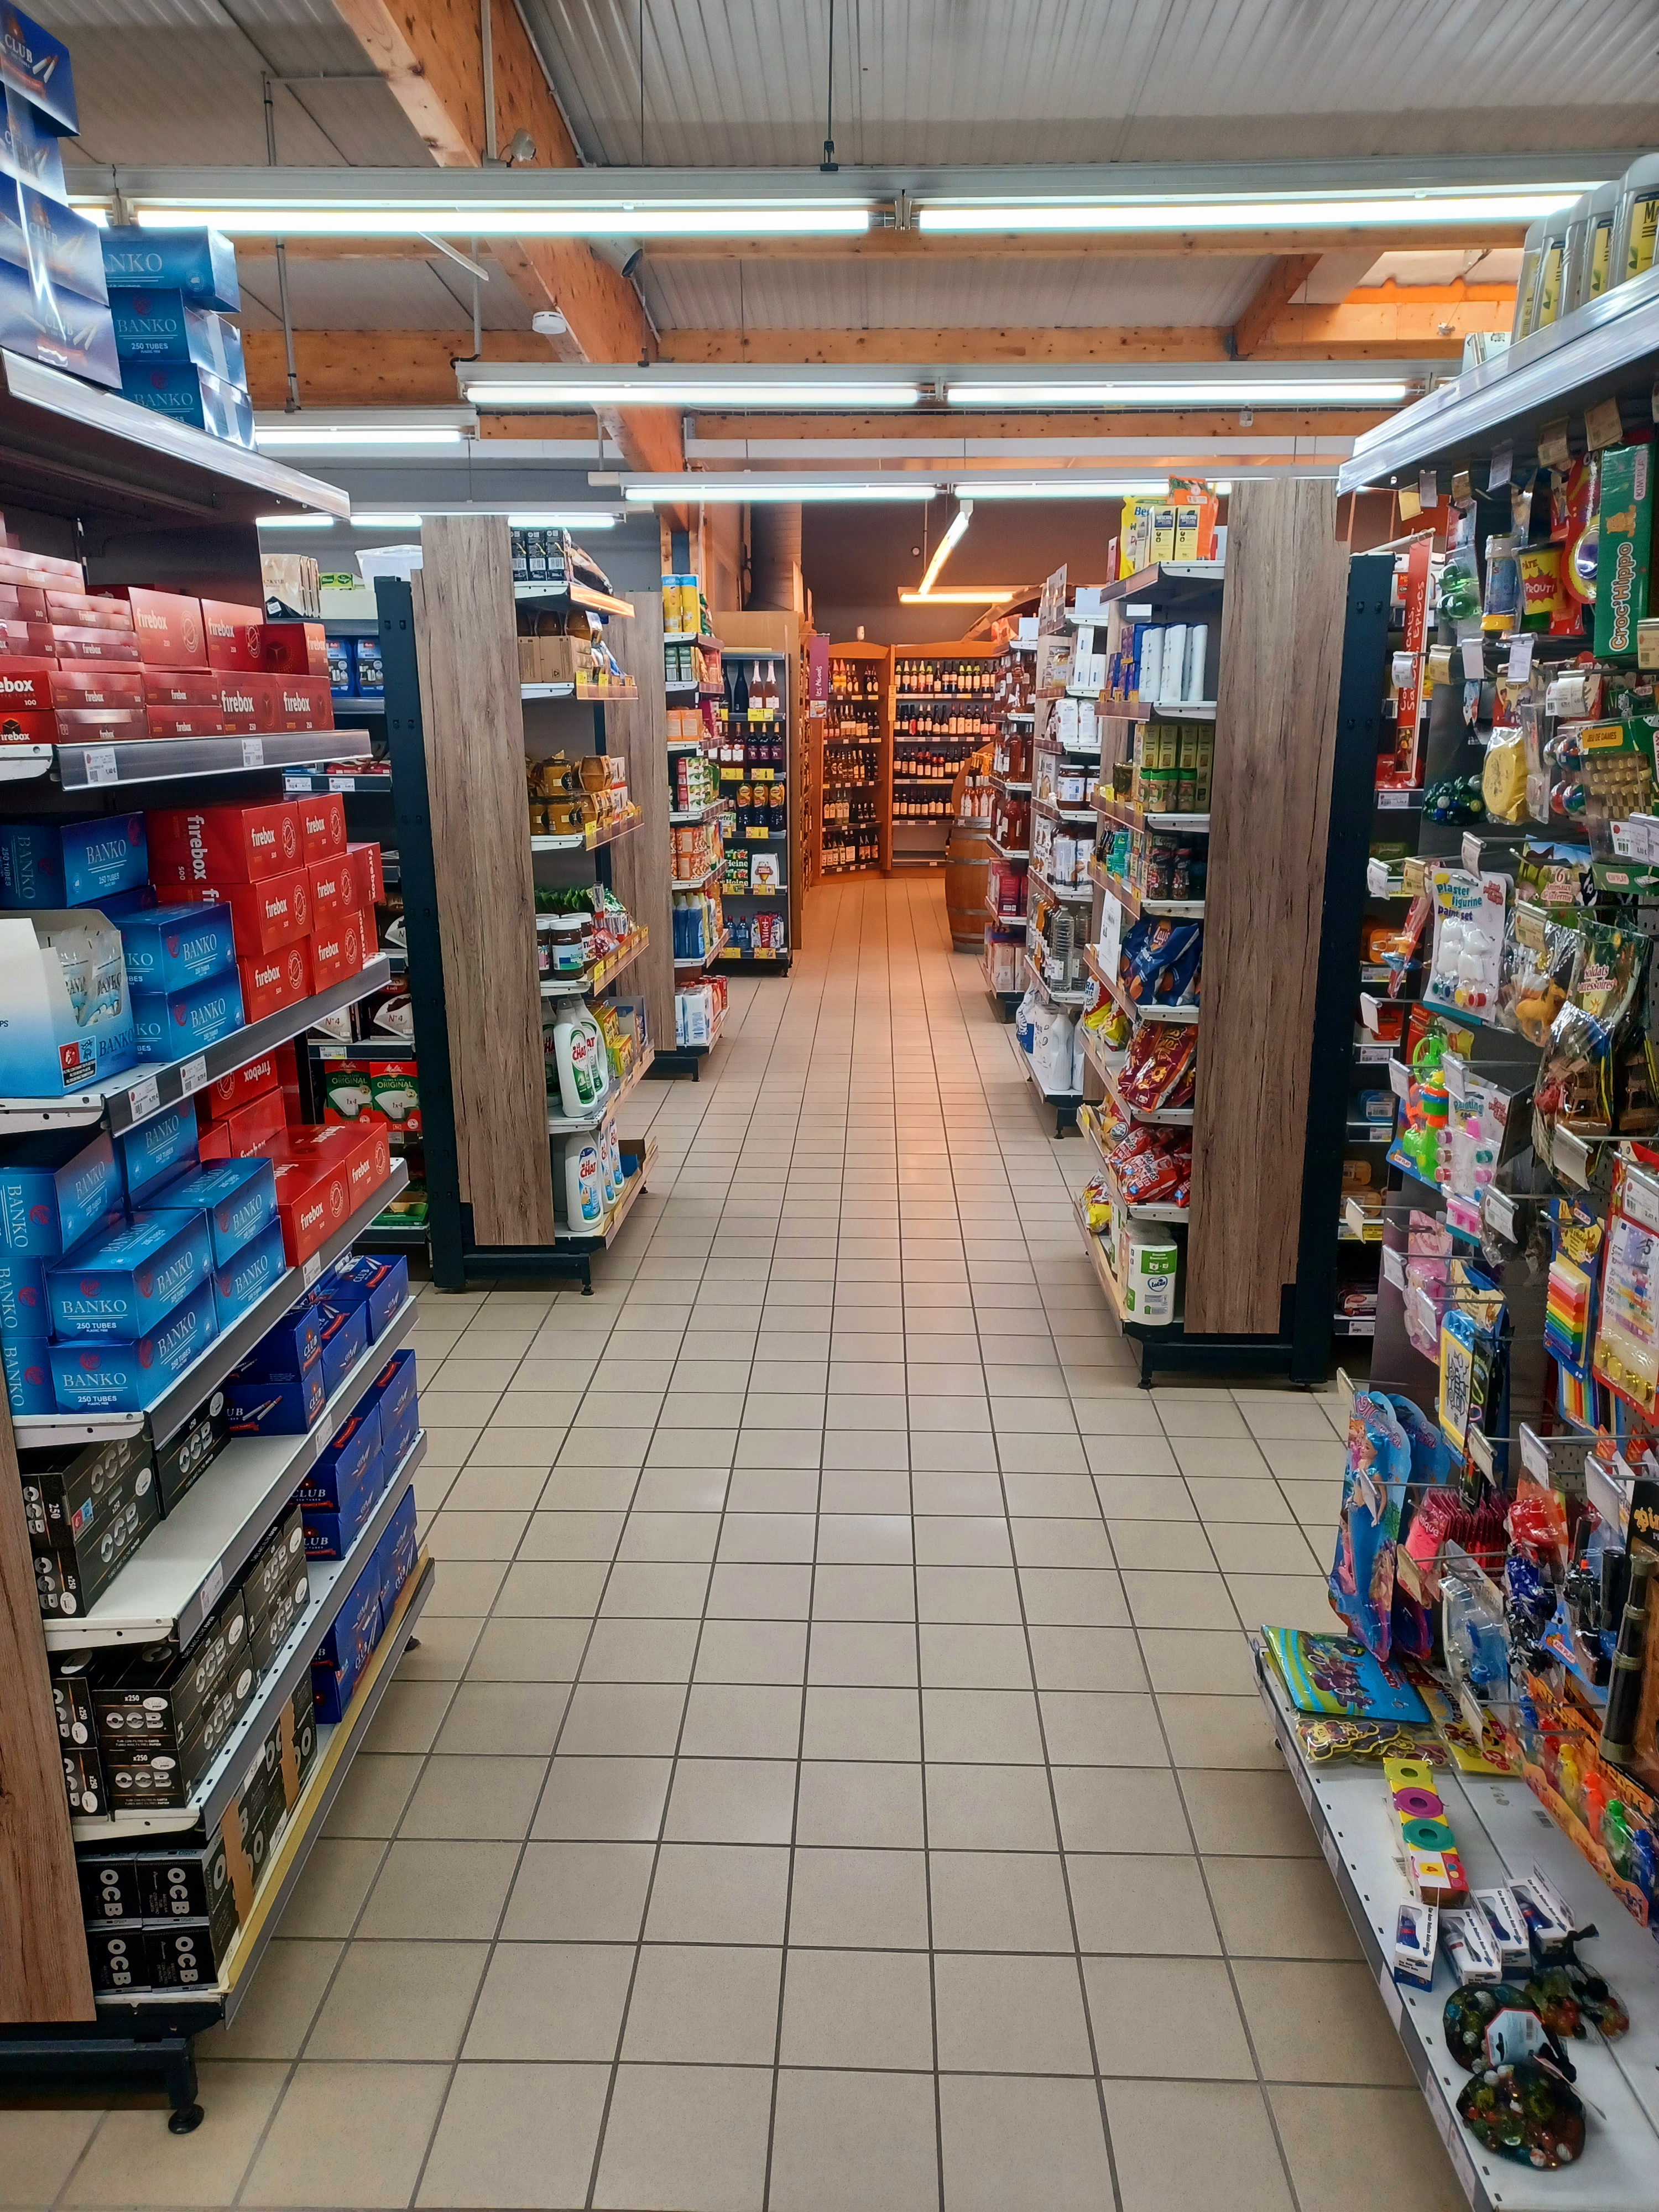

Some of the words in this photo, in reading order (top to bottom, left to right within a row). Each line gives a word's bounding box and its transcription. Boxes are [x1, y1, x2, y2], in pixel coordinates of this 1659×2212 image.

[4, 34, 33, 63] CLUB
[104, 253, 163, 272] NKO
[117, 319, 178, 333] BANKO
[134, 393, 193, 406] BANKO
[1636, 453, 1644, 497] KIM'PLA
[1525, 582, 1554, 594] PROUT!
[1610, 543, 1635, 651] Croc'Hippo
[137, 608, 168, 630] firebox
[207, 617, 235, 638] firebox
[82, 644, 102, 654] firebox
[0, 676, 34, 692] ebox
[171, 689, 187, 700] firebox
[85, 691, 104, 702] firebox
[221, 690, 255, 713] firebox
[283, 691, 311, 712] firebox
[176, 722, 192, 732] firebox
[1601, 732, 1617, 740] DAMES
[251, 826, 275, 847] firebox
[306, 816, 325, 834] firebox
[86, 839, 127, 864] BANKO
[187, 815, 207, 880] firebox
[18, 836, 36, 899] BANKO
[1556, 868, 1563, 882] 6
[317, 879, 335, 899] firebox
[1437, 883, 1470, 895] Plaster
[265, 897, 288, 919] firebox
[1460, 912, 1473, 921] set
[182, 934, 217, 961] BANKO
[1154, 926, 1170, 946] Lay's
[318, 941, 339, 961] firebox
[255, 965, 280, 988] firebox
[191, 998, 226, 1028] BANKO
[98, 1027, 135, 1057] BANKO
[572, 1046, 586, 1061] CHAT
[587, 1037, 595, 1048] AT
[145, 1115, 179, 1148] BANKO
[75, 1161, 105, 1200] BANKO
[352, 1159, 370, 1184] firebox
[580, 1162, 596, 1177] CHAT
[7, 1185, 28, 1248] BANKO
[233, 1194, 262, 1231] BANKO
[300, 1202, 324, 1231] firebox
[99, 1223, 150, 1253] BANKO
[1644, 1239, 1654, 1255] 5
[156, 1251, 193, 1295] BANKO
[234, 1254, 268, 1295] BANKO
[353, 1269, 370, 1282] CLUB
[0, 1267, 18, 1328] BANKO
[61, 1300, 127, 1313] BANKO
[158, 1311, 196, 1358] BANKO
[304, 1335, 317, 1356] CLUB
[3, 1346, 24, 1407] BANKO
[62, 1373, 127, 1387] BANKO
[309, 1387, 322, 1410] CLUB
[179, 1421, 212, 1473] OCB
[91, 1438, 131, 1494] OCB
[23, 1486, 45, 1535] OCB
[101, 1502, 138, 1563] OCB
[304, 1537, 328, 1545] LUB
[263, 1545, 288, 1592] OCB
[34, 1557, 58, 1610] OCB
[67, 1575, 76, 1590] x250
[270, 1596, 293, 1645] OCB
[196, 1637, 227, 1693] OCB
[79, 1706, 87, 1720] x250
[106, 1712, 164, 1729] OCB
[204, 1692, 234, 1750] OCB
[89, 1775, 98, 1789] x250
[116, 1771, 172, 1788] OCB
[100, 1869, 123, 1916] OCB
[168, 1867, 190, 1914] OCB
[108, 1939, 131, 1985] OCB
[175, 1936, 198, 1983] OCB
